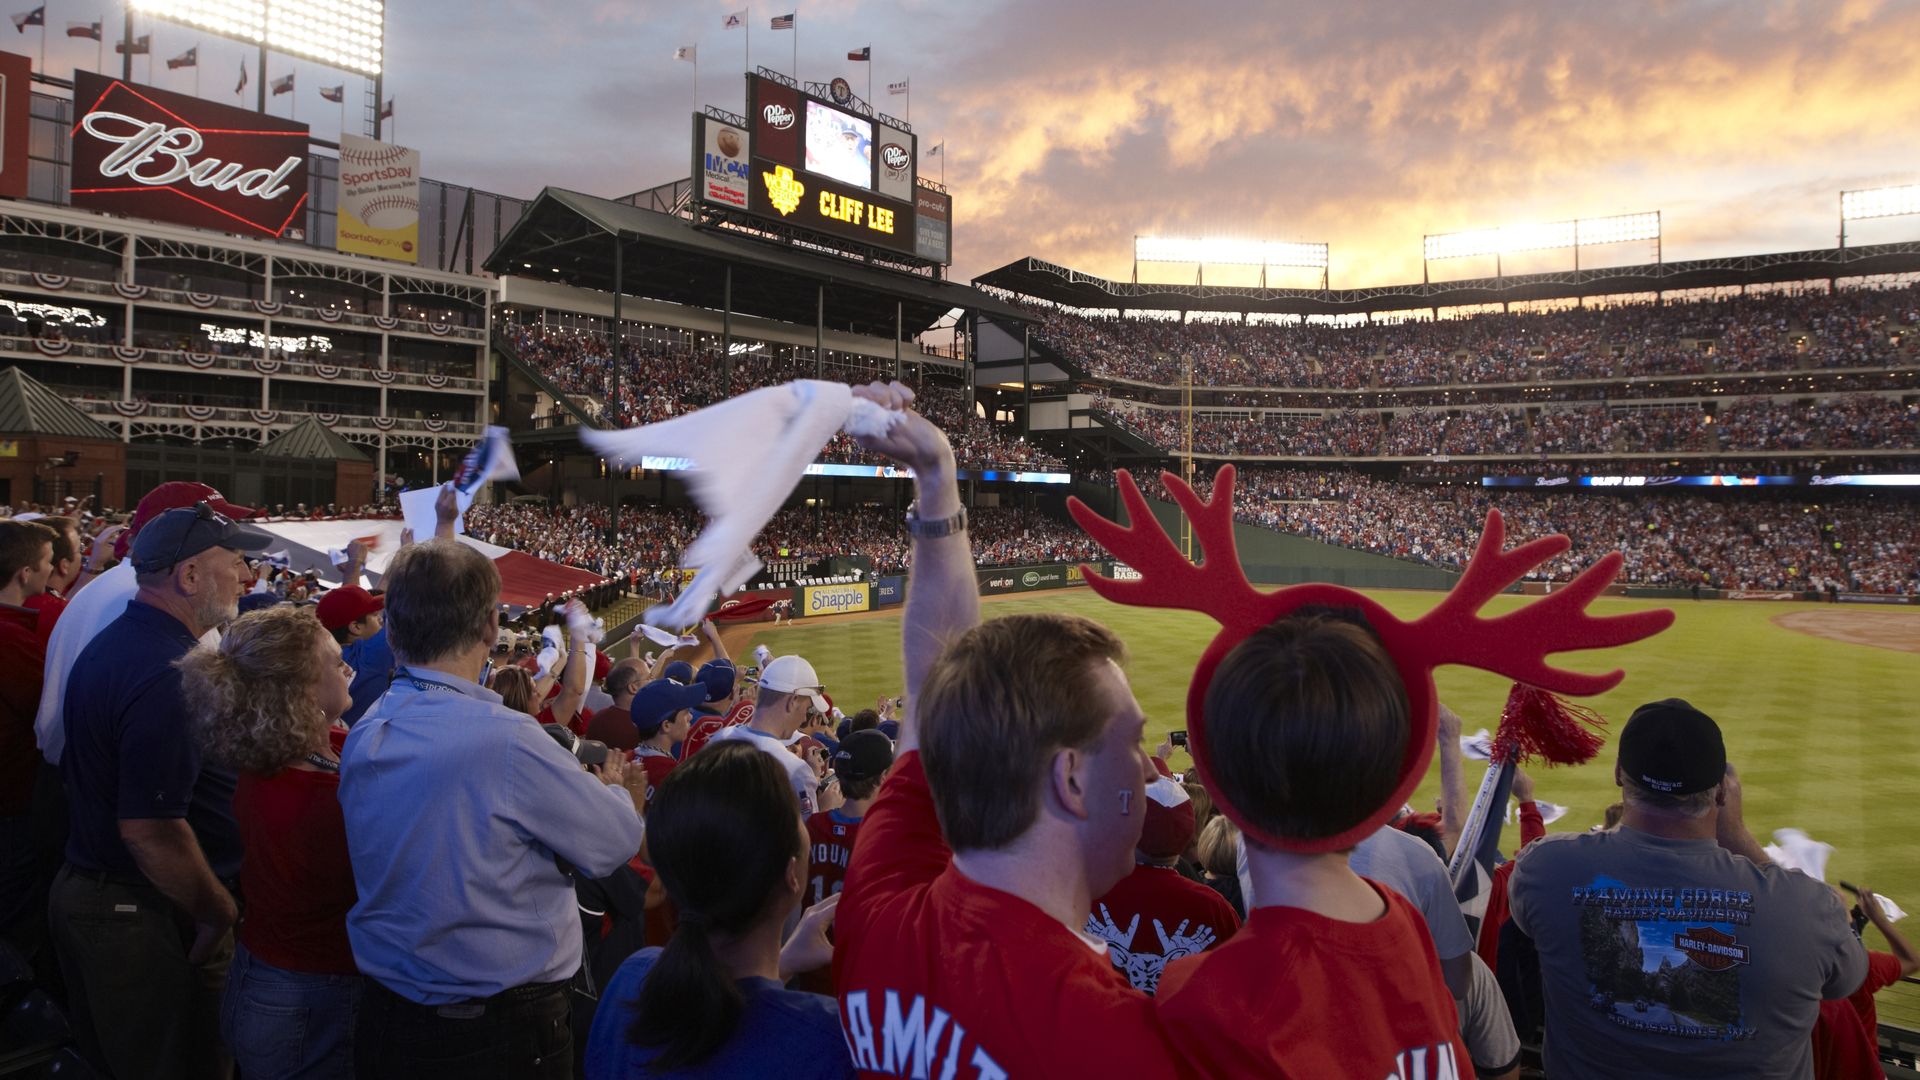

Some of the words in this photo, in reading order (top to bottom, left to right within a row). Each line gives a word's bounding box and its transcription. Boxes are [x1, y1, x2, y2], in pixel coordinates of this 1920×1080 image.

[764, 105, 792, 126] Pepper
[775, 105, 786, 115] Dr
[82, 111, 302, 200] Bud
[885, 147, 907, 166] Pepper
[342, 167, 411, 186] SportsDay
[820, 190, 863, 225] CLIFF
[868, 204, 894, 235] LEE
[767, 563, 807, 574] SHARPER
[773, 572, 802, 581] IMAGE
[990, 577, 1014, 588] verizon
[812, 589, 863, 611] Snapple
[1119, 789, 1133, 816] T
[811, 843, 849, 867] YOUN
[1572, 886, 1674, 907] FLAMING
[1680, 888, 1756, 910] GORGE
[1604, 907, 1751, 923] HARLEY-DAVIDSON
[1679, 937, 1745, 959] HARLEY-DAVIDSON
